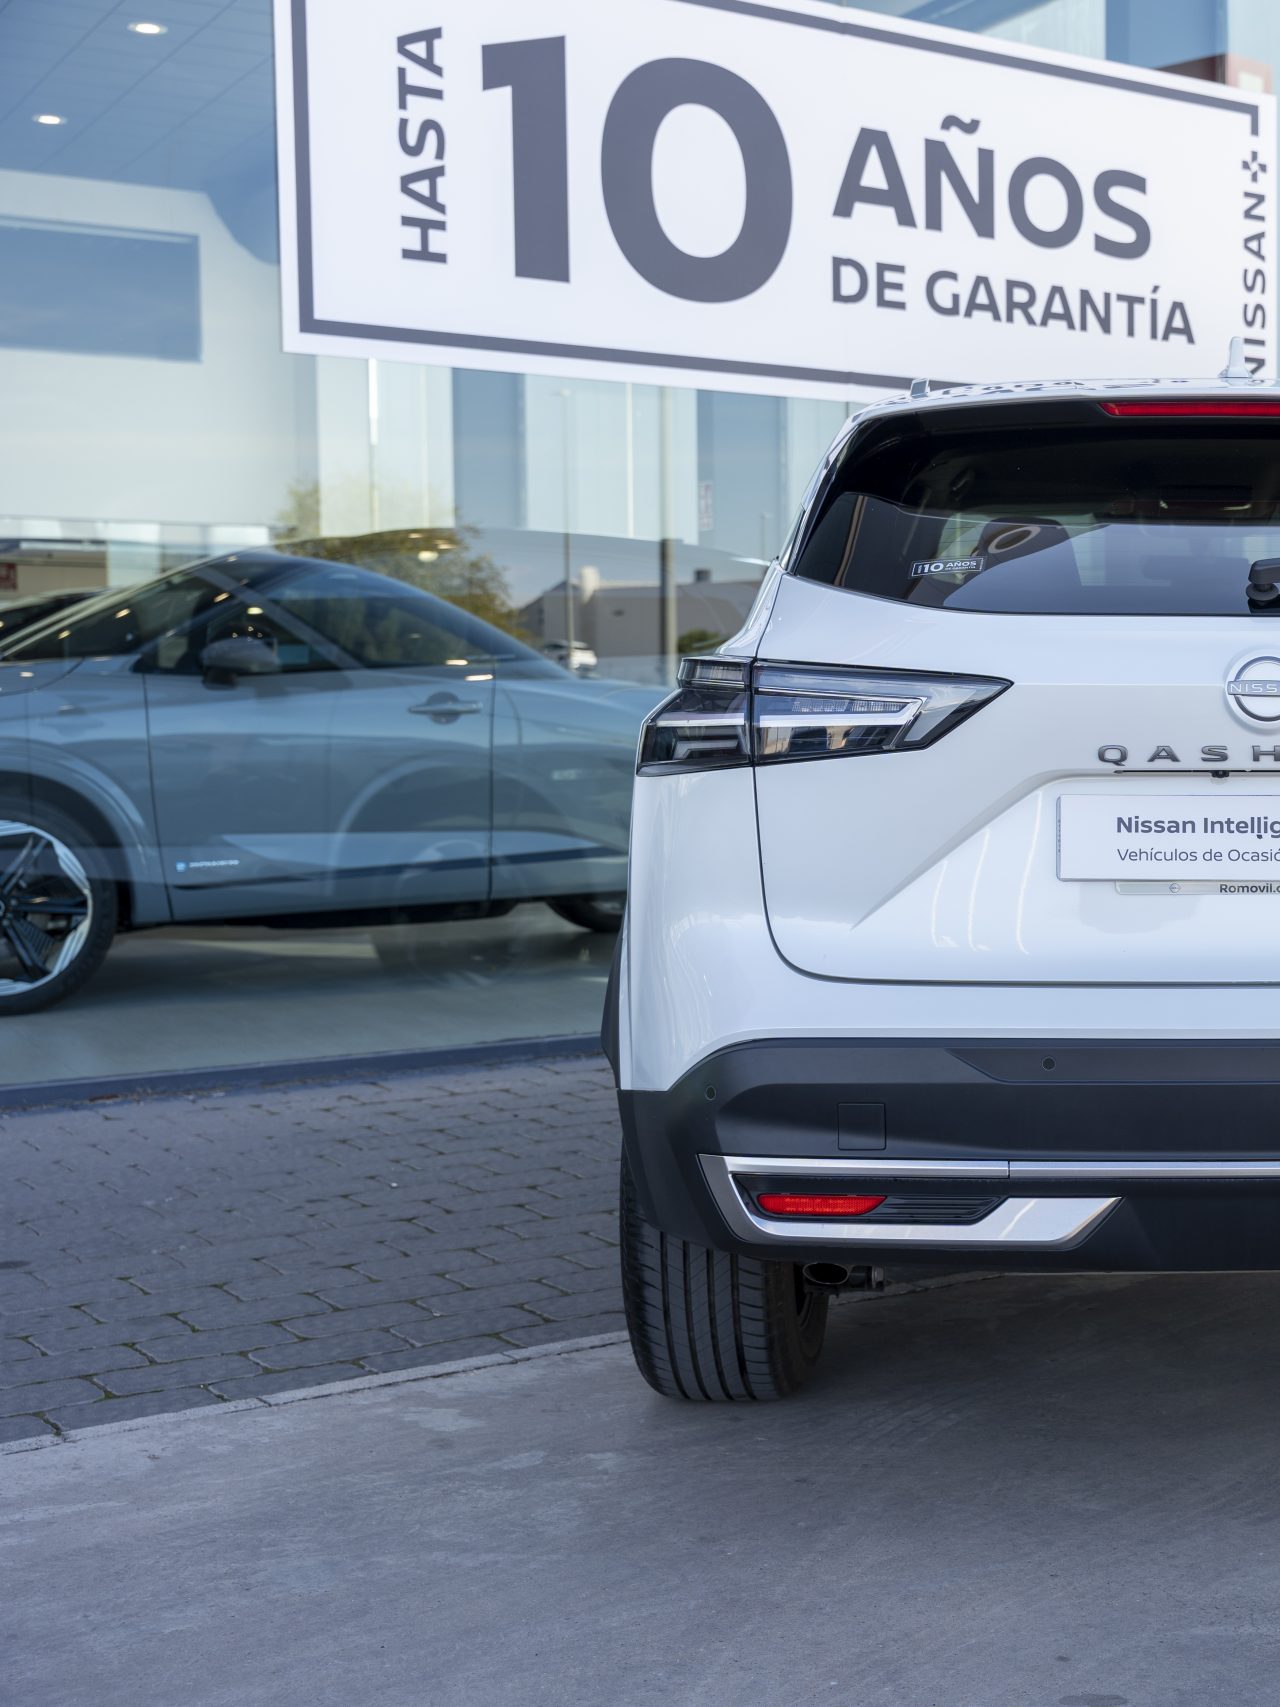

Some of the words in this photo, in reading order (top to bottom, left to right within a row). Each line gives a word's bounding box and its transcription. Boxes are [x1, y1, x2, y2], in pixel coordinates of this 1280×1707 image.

[396, 26, 447, 264] HASTA
[481, 35, 793, 304] 10
[831, 114, 1151, 259] AÑOS
[831, 255, 906, 311] DE
[925, 271, 1195, 345] GARANTÍA
[1116, 816, 1196, 834] Nissan
[1116, 848, 1198, 862] Vehículos
[1202, 848, 1223, 862] de
